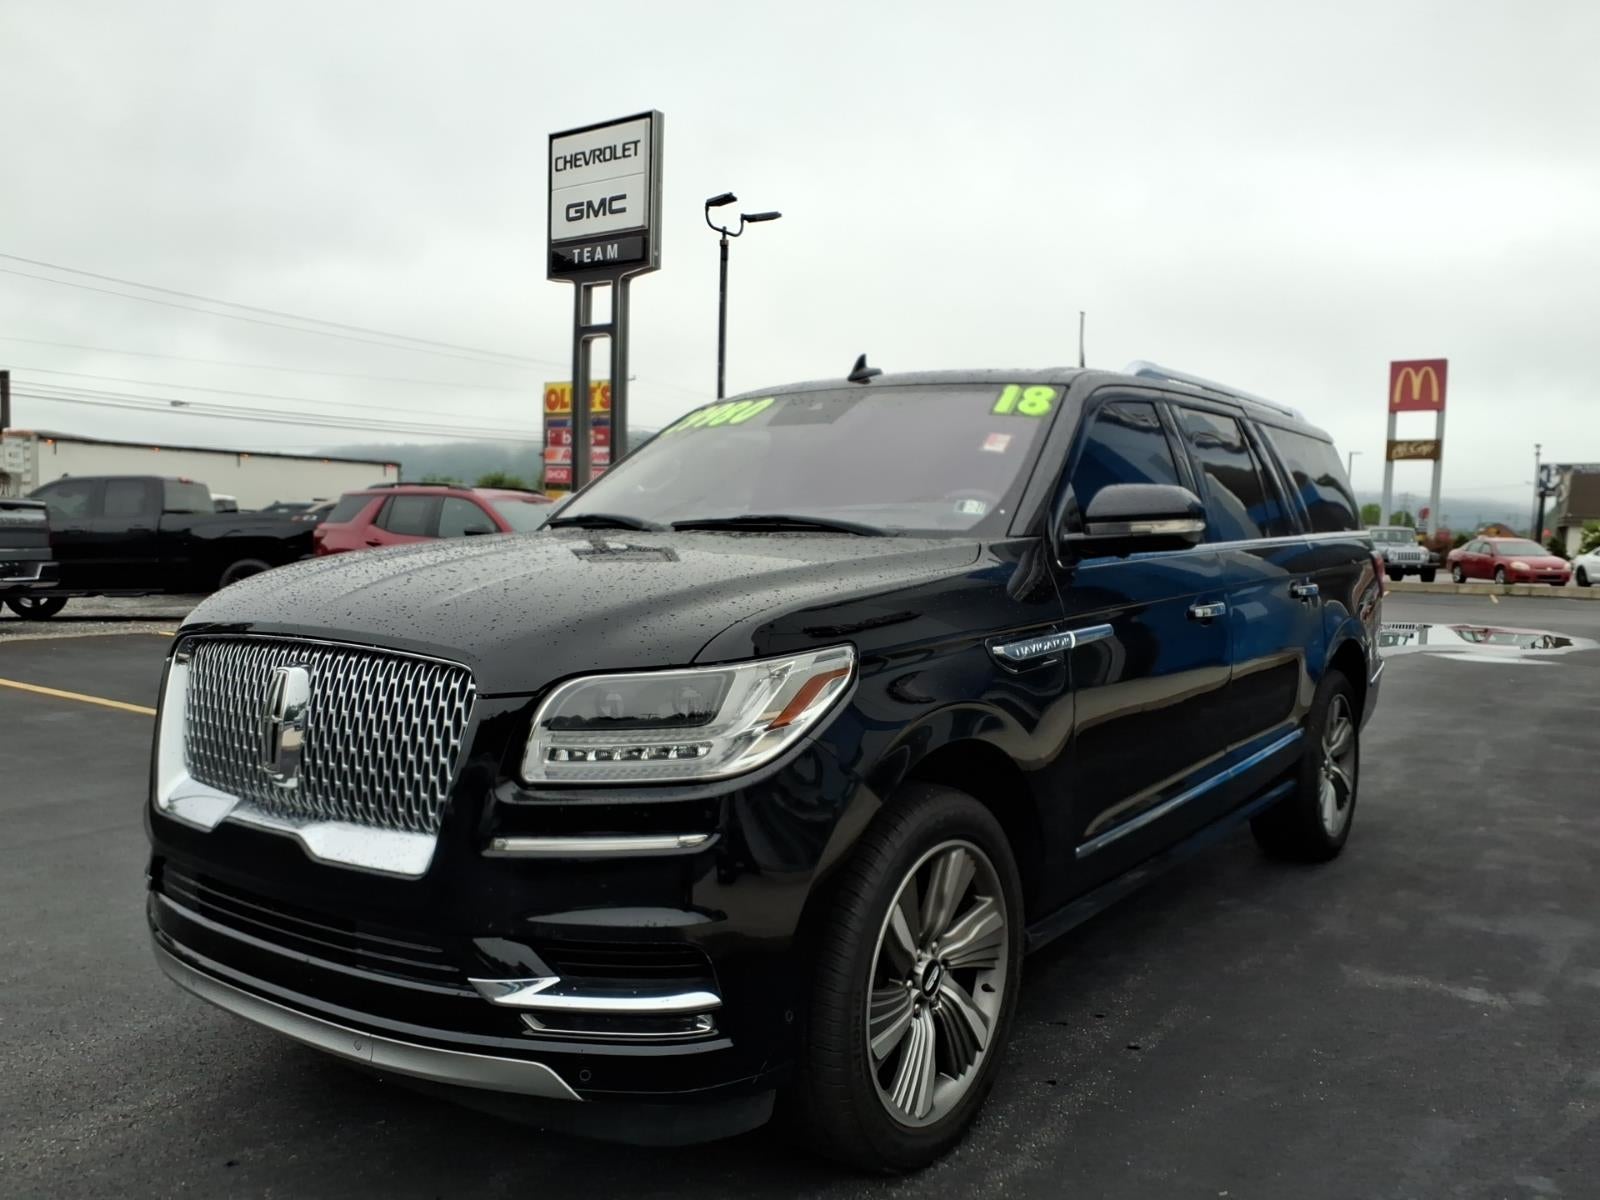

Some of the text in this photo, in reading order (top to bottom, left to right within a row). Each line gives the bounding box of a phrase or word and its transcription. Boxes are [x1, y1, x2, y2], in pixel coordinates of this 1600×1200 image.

[555, 139, 641, 173] CHEVROLET
[566, 194, 627, 222] GMC
[573, 244, 618, 264] TEAM
[993, 384, 1056, 416] 18
